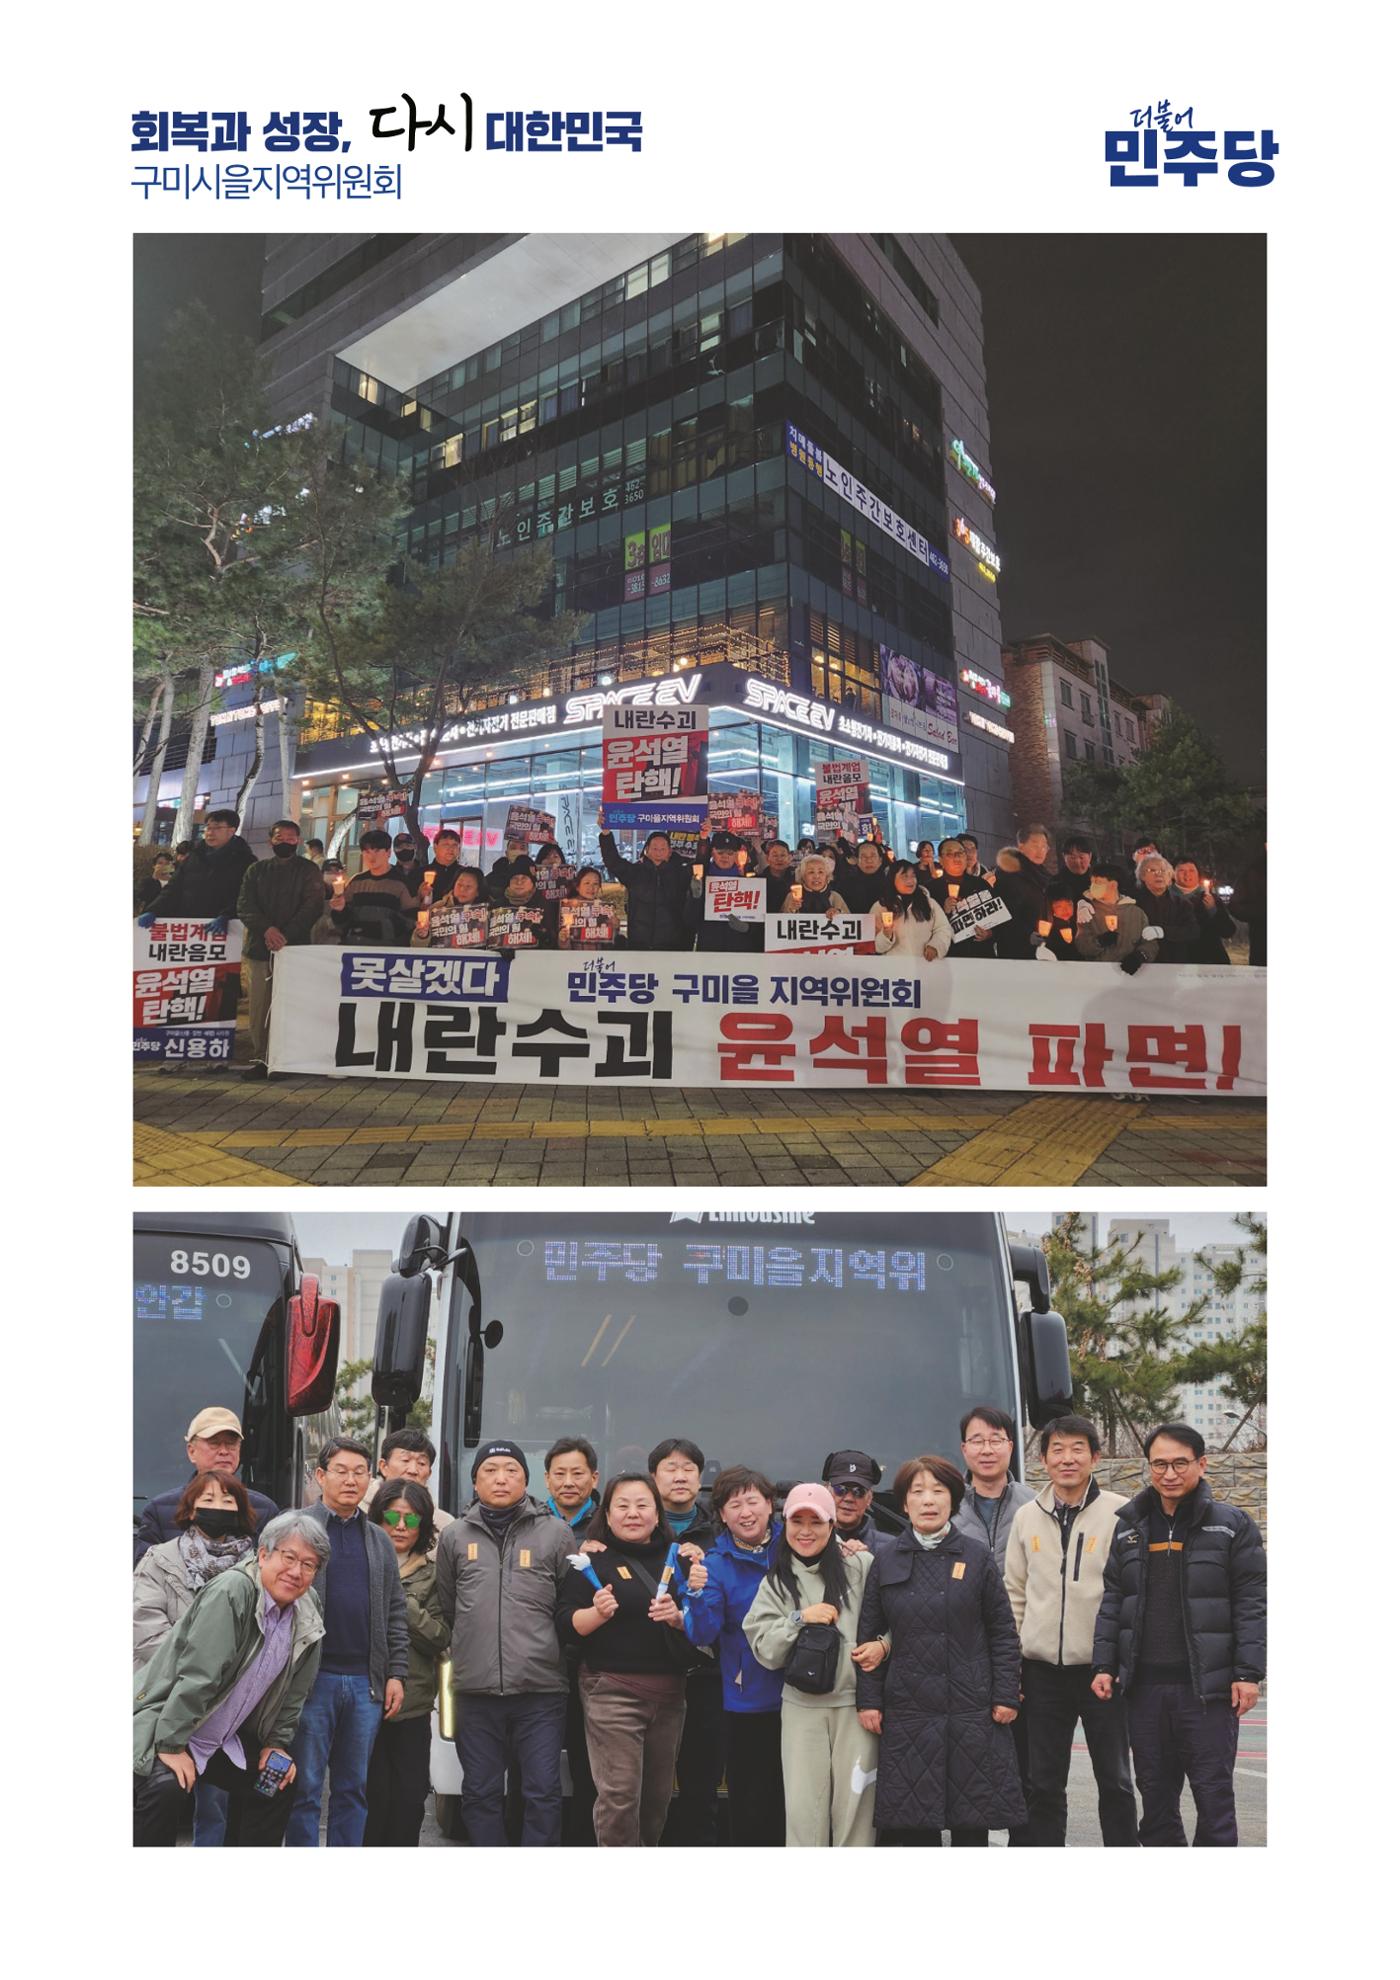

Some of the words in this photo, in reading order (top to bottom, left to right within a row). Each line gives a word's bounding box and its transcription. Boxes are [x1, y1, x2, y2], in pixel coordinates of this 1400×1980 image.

[825, 456, 929, 565] 노인주간보호센터
[743, 678, 811, 725] SPACE
[614, 710, 697, 730] 내란수괴
[607, 735, 689, 770] 윤석열
[616, 767, 682, 800] 탄핵!
[713, 890, 761, 913] 탄핵!
[950, 898, 1003, 935] 파면하라!
[777, 919, 862, 940] 내란수괴
[148, 943, 227, 963] 내란음모
[582, 956, 616, 974] 더불어
[134, 966, 217, 999] 윤석열
[350, 956, 501, 998] 못살겠다
[567, 972, 660, 1005] 민주당
[672, 973, 760, 1006] 구미을
[769, 974, 923, 1010] 지역위원회
[142, 994, 208, 1026] 탄핵!
[163, 1038, 231, 1059] 신용하
[335, 1001, 673, 1080] 내란수괴
[717, 1010, 982, 1087] 윤석열
[1027, 1022, 1242, 1091] 파면!
[170, 1249, 251, 1280] 8509
[544, 1240, 663, 1282] 민주당
[683, 1243, 928, 1292] 구미을지역위
